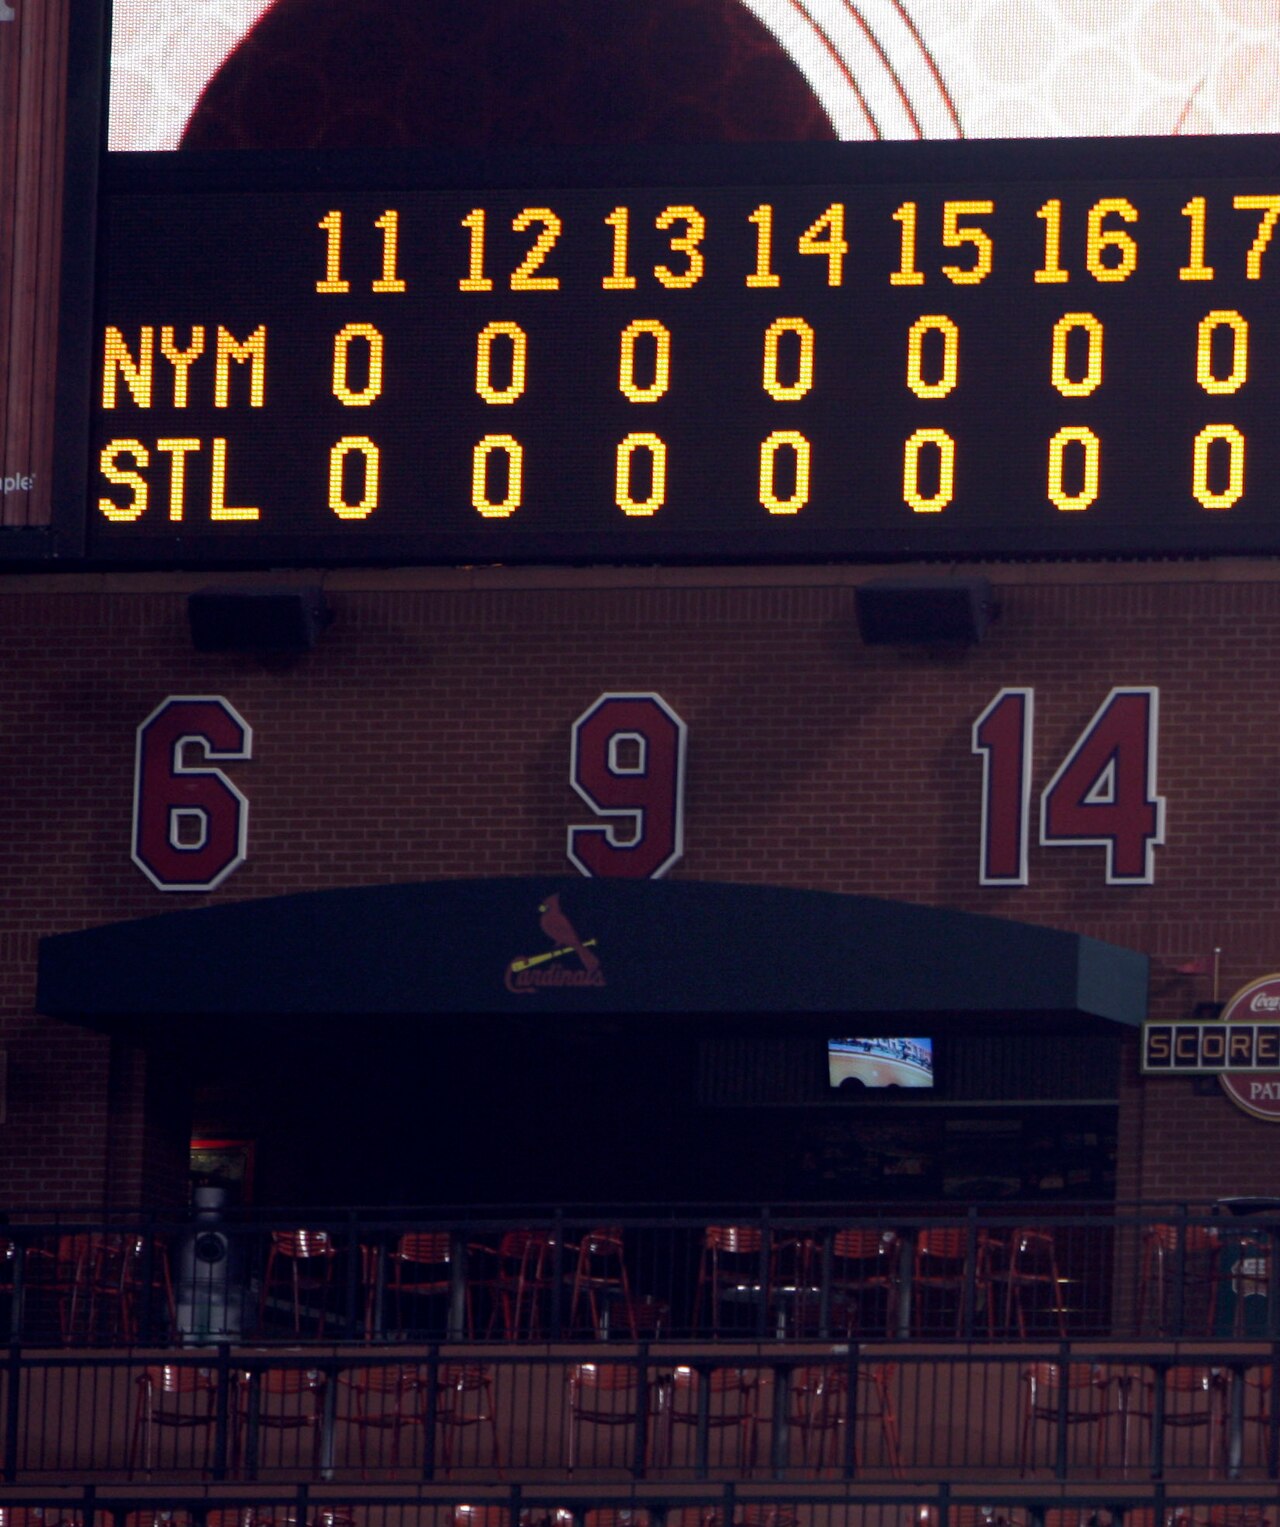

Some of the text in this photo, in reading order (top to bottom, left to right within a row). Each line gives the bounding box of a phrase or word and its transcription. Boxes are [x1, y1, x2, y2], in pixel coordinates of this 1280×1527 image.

[317, 211, 405, 292] 11
[460, 209, 560, 291] 12
[603, 207, 704, 289] 13
[747, 204, 847, 287] 14
[891, 201, 993, 285] 15
[1035, 199, 1137, 283] 16
[103, 326, 265, 408] NYM
[333, 324, 382, 405] 0
[476, 322, 526, 404] 0
[620, 320, 669, 402] 0
[763, 318, 813, 400] 0
[907, 316, 958, 398] 0
[1052, 313, 1102, 396] 0
[1197, 311, 1247, 394] 0
[99, 439, 259, 521] STL
[329, 437, 378, 518] 0
[472, 435, 522, 517] 0
[616, 433, 666, 515] 0
[760, 431, 810, 514] 0
[904, 429, 954, 512] 0
[1048, 427, 1099, 510] 0
[1193, 425, 1244, 508] 0
[131, 695, 252, 891] 6
[567, 693, 687, 880] 9
[972, 686, 1166, 885] 14
